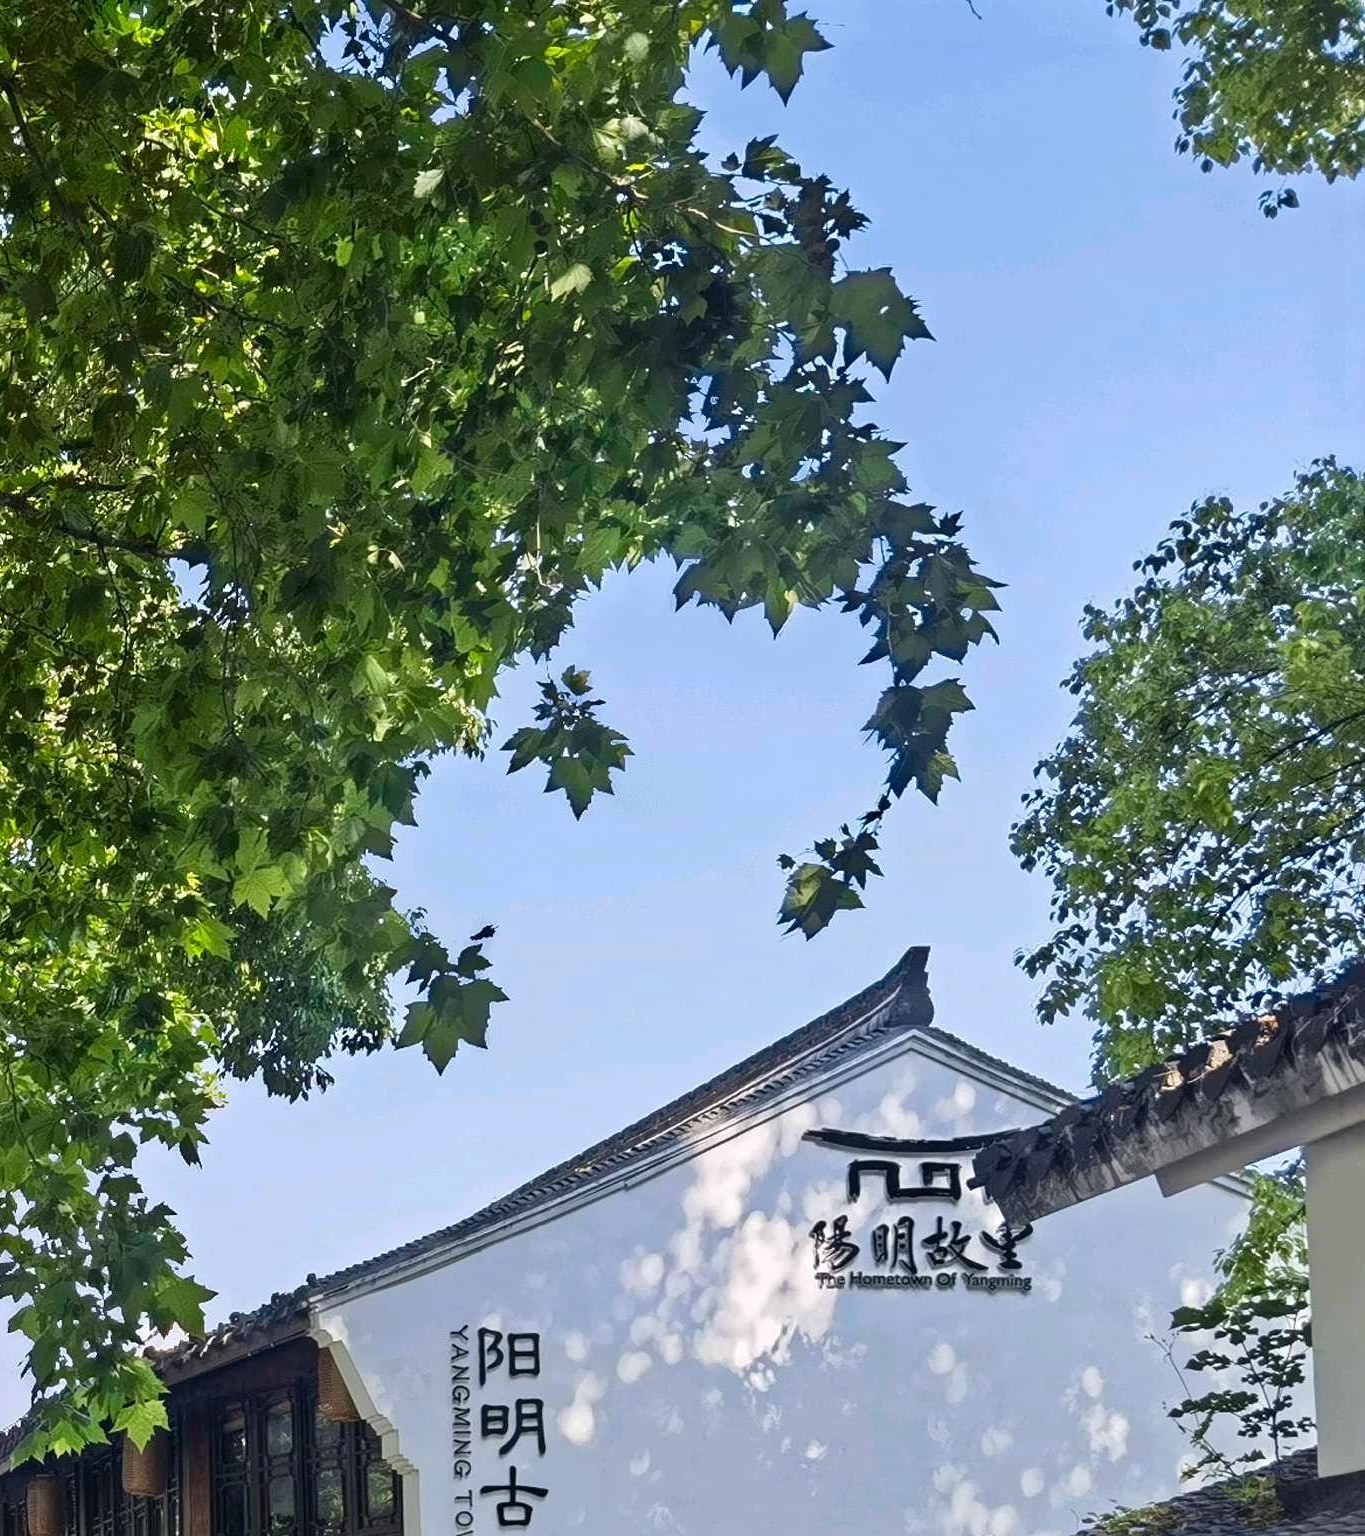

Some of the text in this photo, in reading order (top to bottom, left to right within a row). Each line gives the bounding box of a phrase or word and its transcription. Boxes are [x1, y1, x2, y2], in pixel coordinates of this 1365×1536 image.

[815, 1271, 1032, 1293] The Hometown Of Yangming
[449, 1324, 473, 1480] YANGMING
